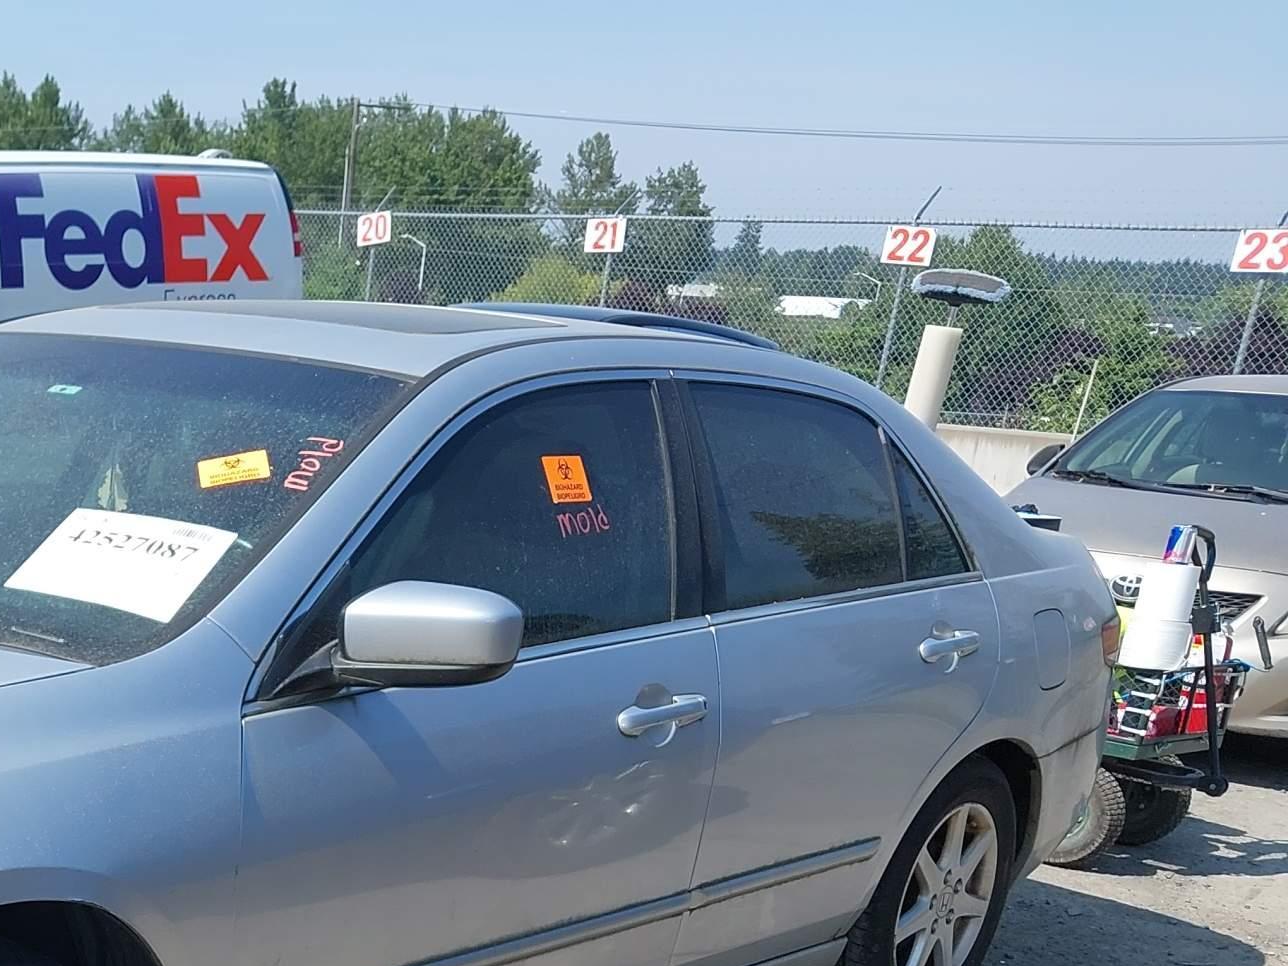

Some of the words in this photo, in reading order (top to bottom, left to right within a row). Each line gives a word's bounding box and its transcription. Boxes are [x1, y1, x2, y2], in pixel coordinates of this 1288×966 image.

[362, 215, 387, 242] 20
[592, 220, 618, 249] 21
[887, 228, 930, 262] 22
[1238, 232, 1288, 270] 23
[284, 436, 344, 491] mold
[555, 483, 583, 491] BIOHAZARD
[556, 503, 610, 538] mold
